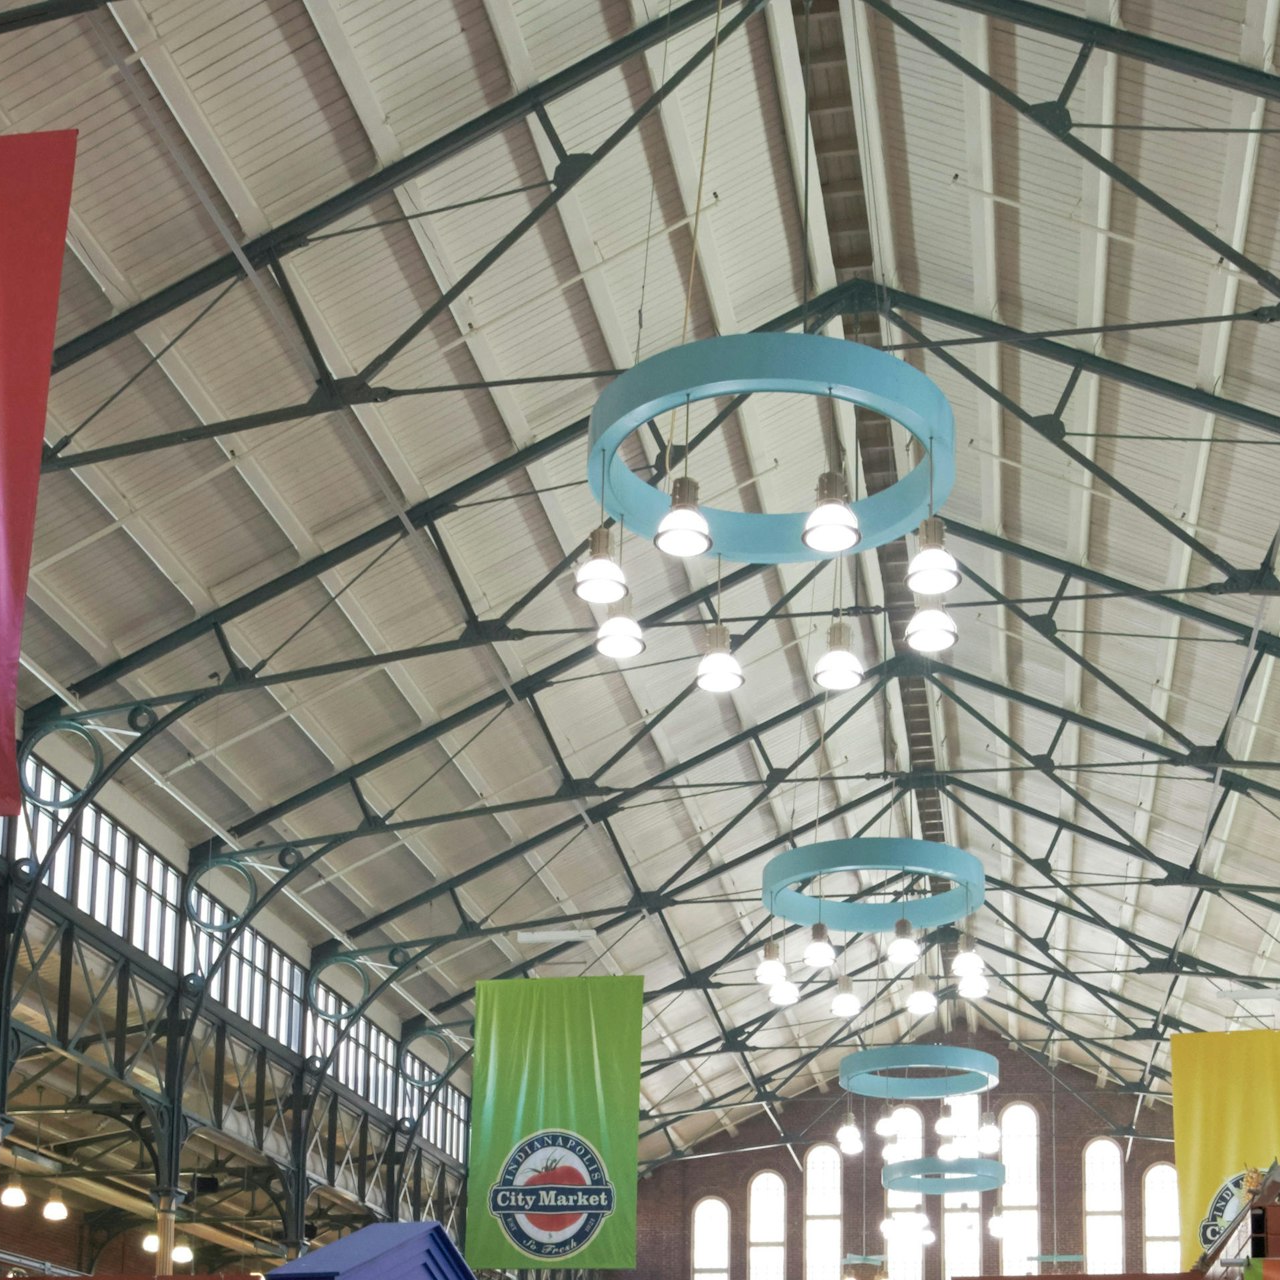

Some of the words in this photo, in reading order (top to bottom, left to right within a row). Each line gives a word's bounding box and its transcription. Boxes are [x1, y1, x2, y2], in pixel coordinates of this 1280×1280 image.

[505, 1135, 601, 1181] INDIANAPOLIS
[496, 1190, 536, 1210] City
[538, 1189, 609, 1207] Market
[523, 1239, 538, 1252] So
[541, 1239, 578, 1255] Fresh
